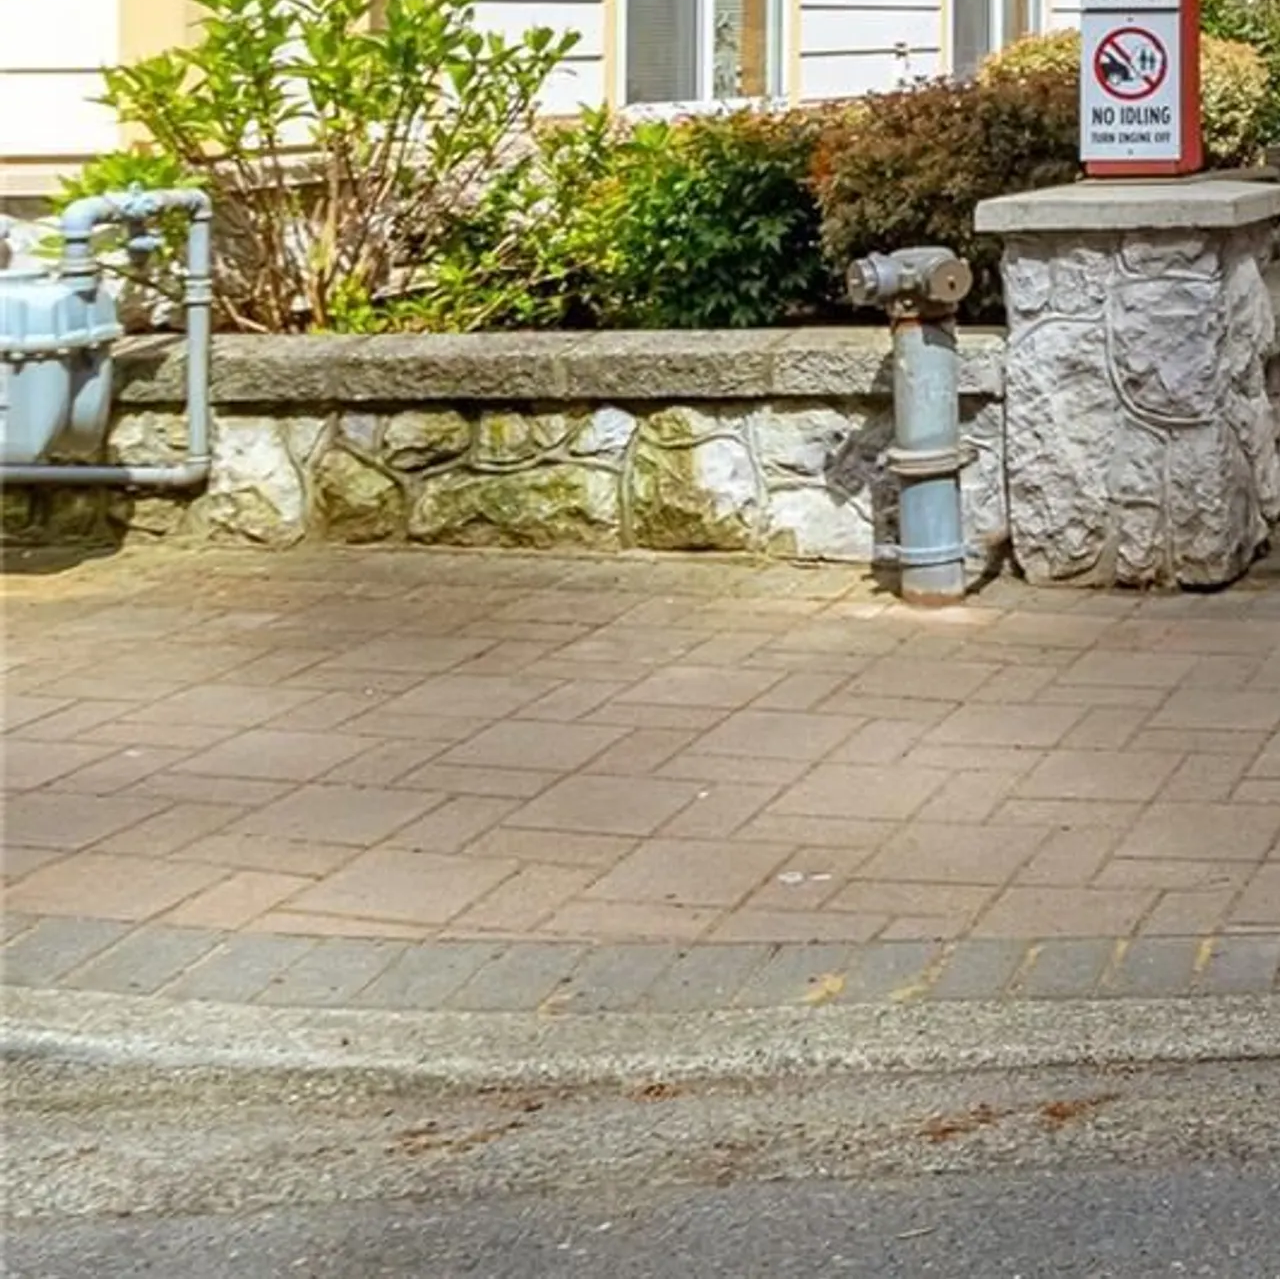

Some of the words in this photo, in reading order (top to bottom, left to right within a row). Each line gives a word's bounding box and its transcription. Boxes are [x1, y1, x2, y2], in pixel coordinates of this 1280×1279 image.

[1091, 106, 1116, 126] NO
[1120, 106, 1171, 126] IDLING
[1155, 132, 1171, 144] OFF
